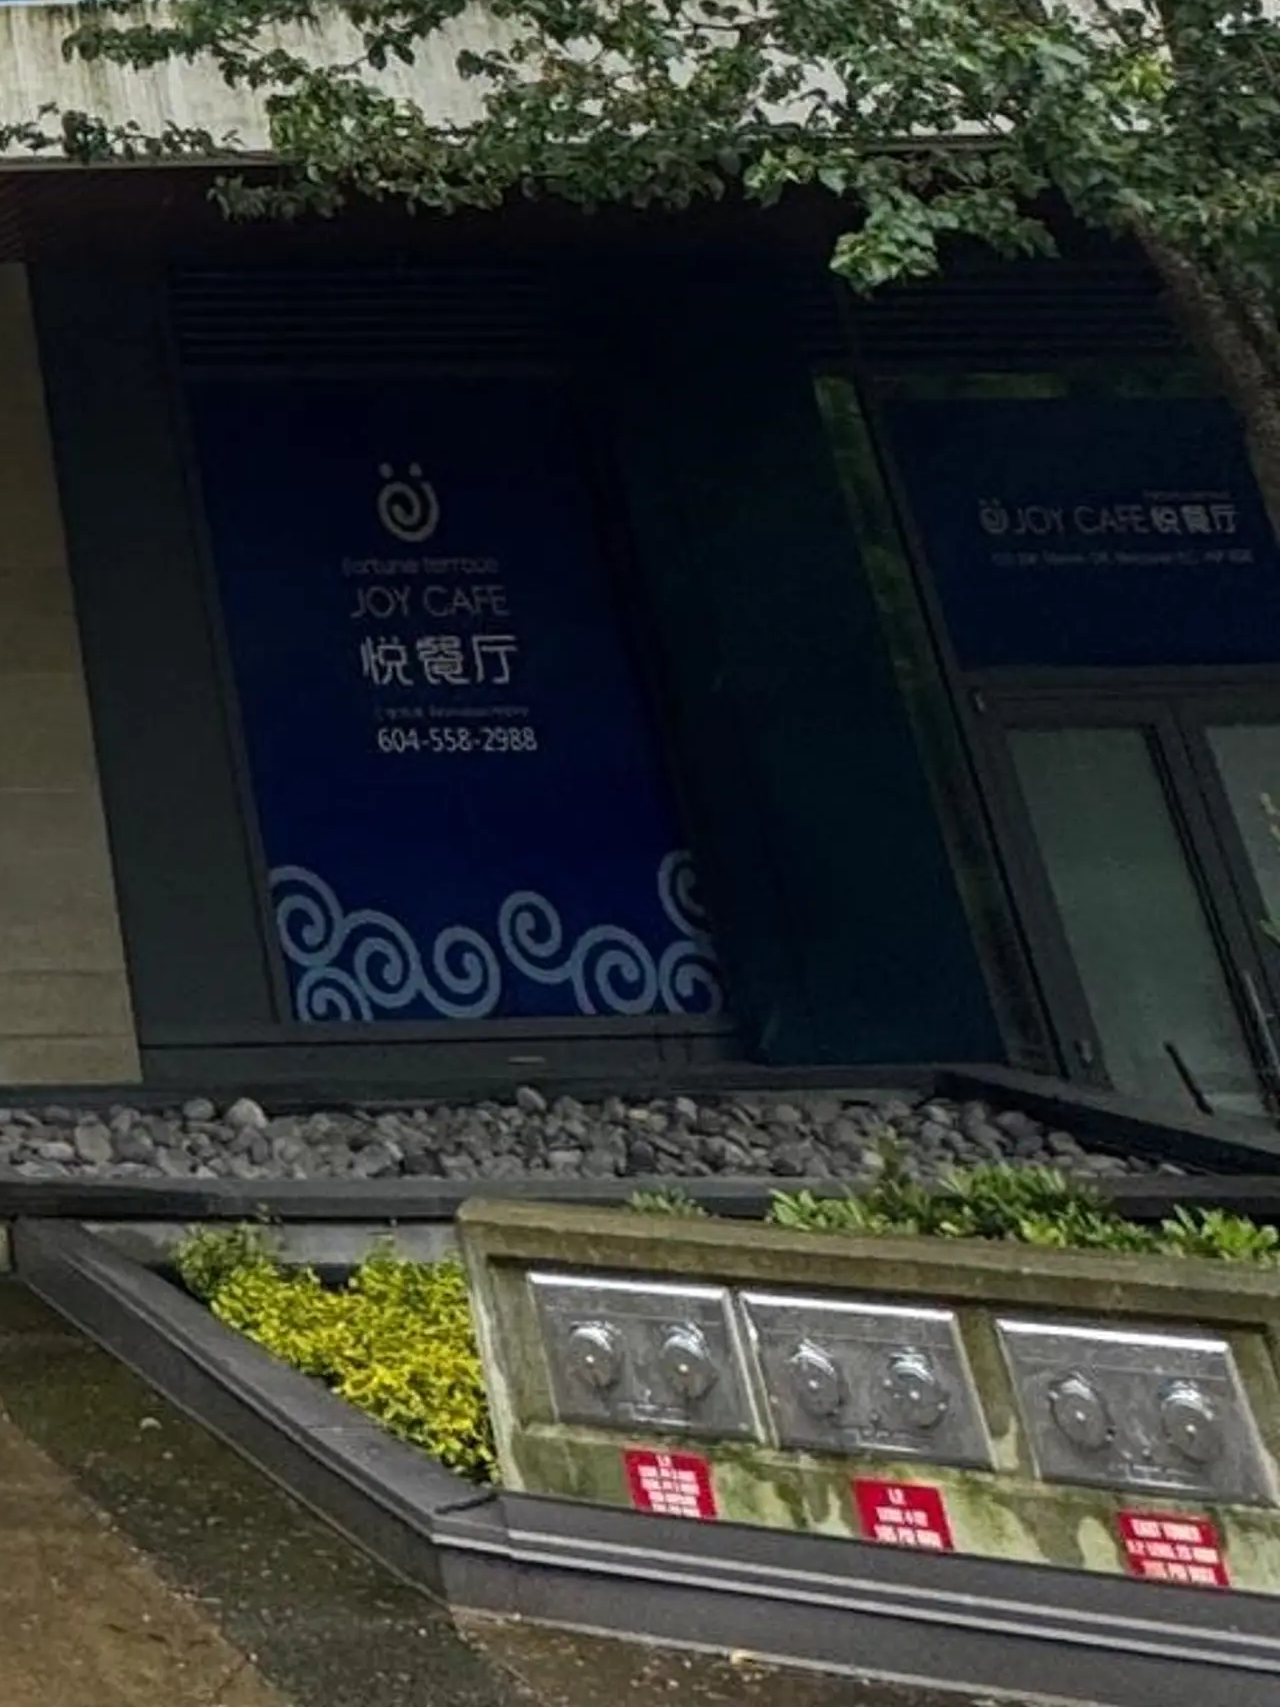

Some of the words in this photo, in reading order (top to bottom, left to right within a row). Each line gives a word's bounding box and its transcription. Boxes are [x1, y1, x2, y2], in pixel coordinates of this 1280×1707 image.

[1013, 505, 1065, 535] JOY
[1074, 504, 1149, 535] CAFE
[350, 584, 412, 619] JOY
[422, 583, 511, 619] CAFE
[359, 633, 520, 686] 悦餐厅
[377, 725, 539, 754] 604-558-2988
